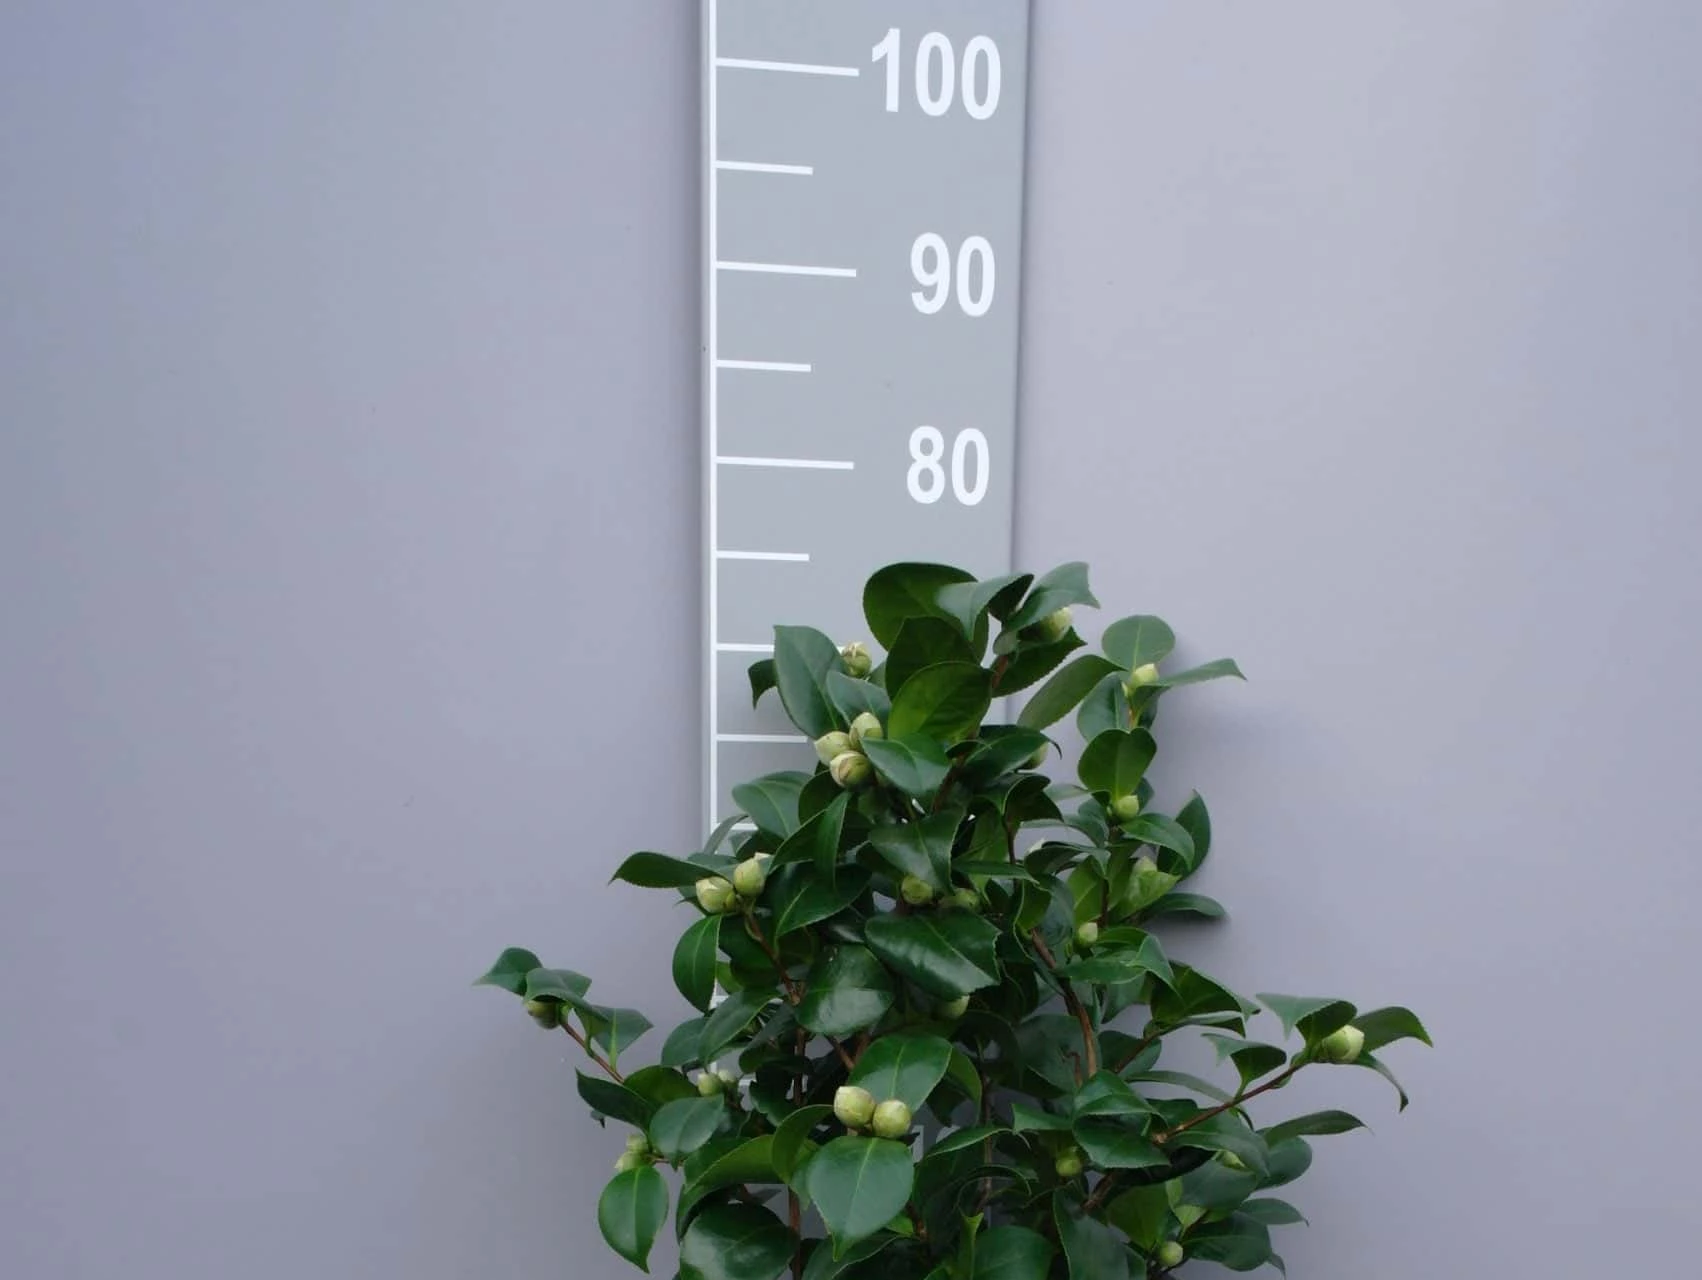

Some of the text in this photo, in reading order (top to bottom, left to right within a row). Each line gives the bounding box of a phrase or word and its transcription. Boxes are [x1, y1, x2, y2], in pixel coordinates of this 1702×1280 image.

[872, 28, 1000, 120] 100
[911, 232, 995, 316] 90
[907, 426, 989, 505] 80
